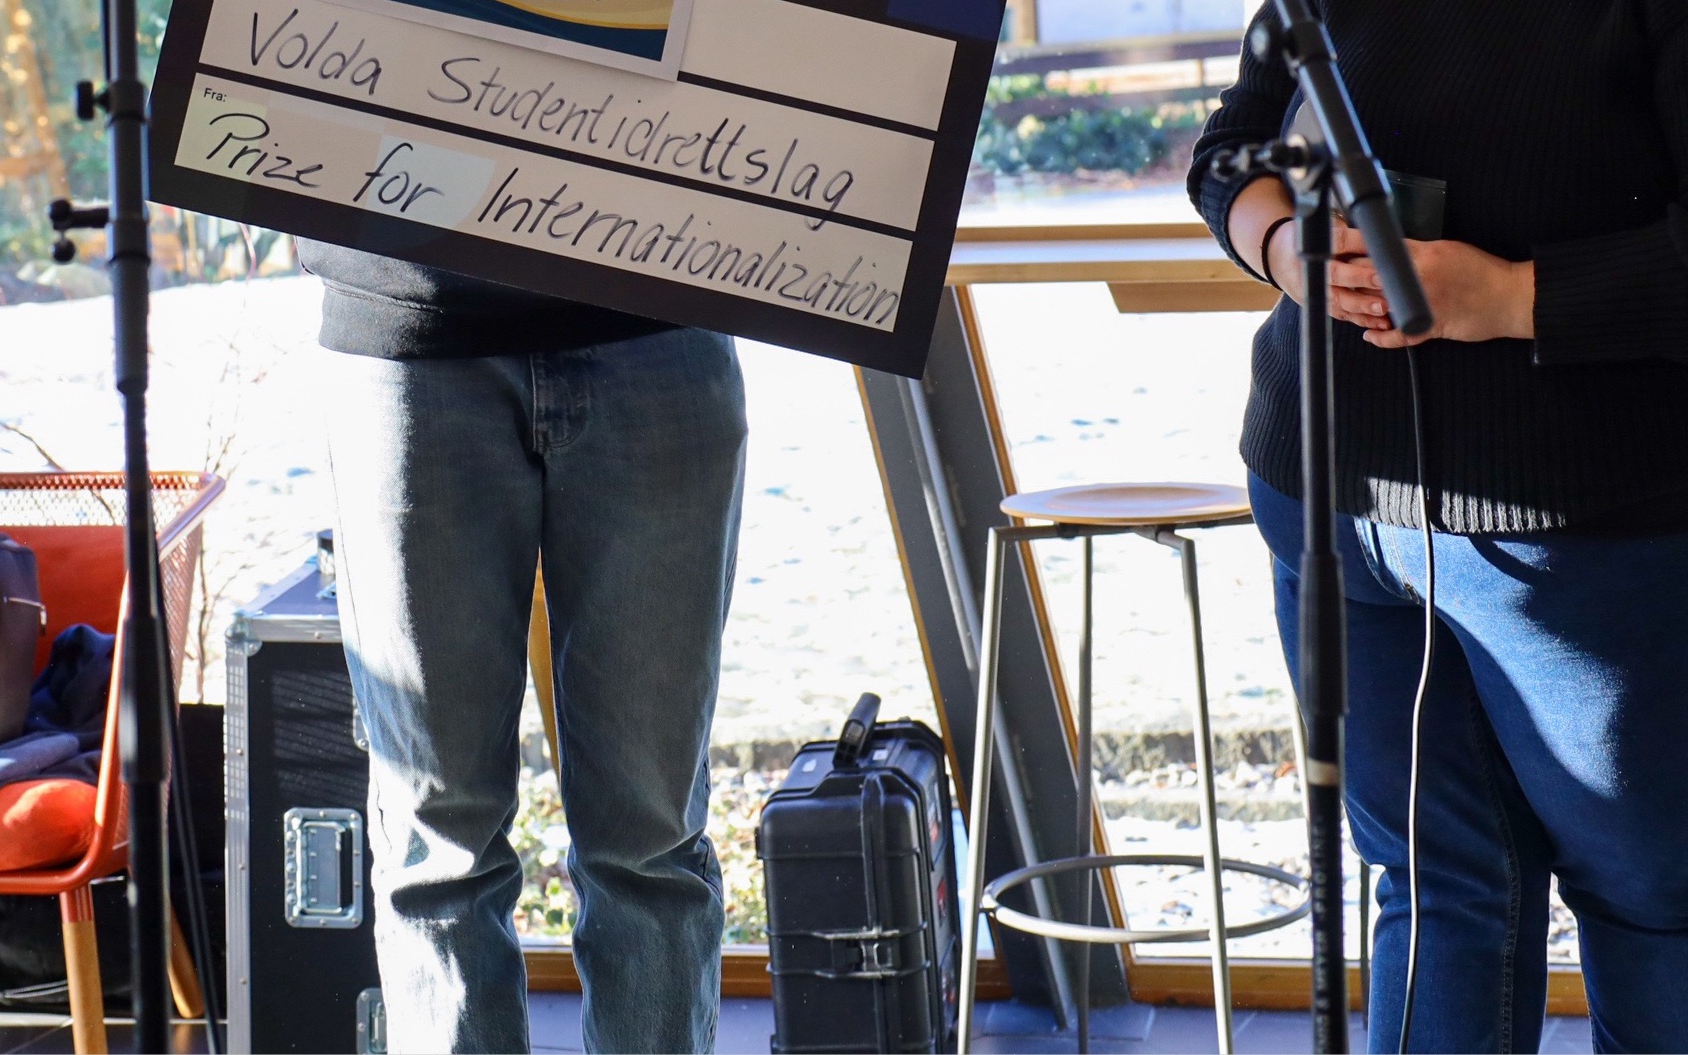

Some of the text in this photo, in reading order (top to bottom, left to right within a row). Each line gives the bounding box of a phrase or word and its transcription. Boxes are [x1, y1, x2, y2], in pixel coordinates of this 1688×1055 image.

[203, 87, 227, 102] Fra:
[250, 8, 855, 231] Volda Studentidrettslag
[208, 112, 900, 325] Prize for Internationalization
